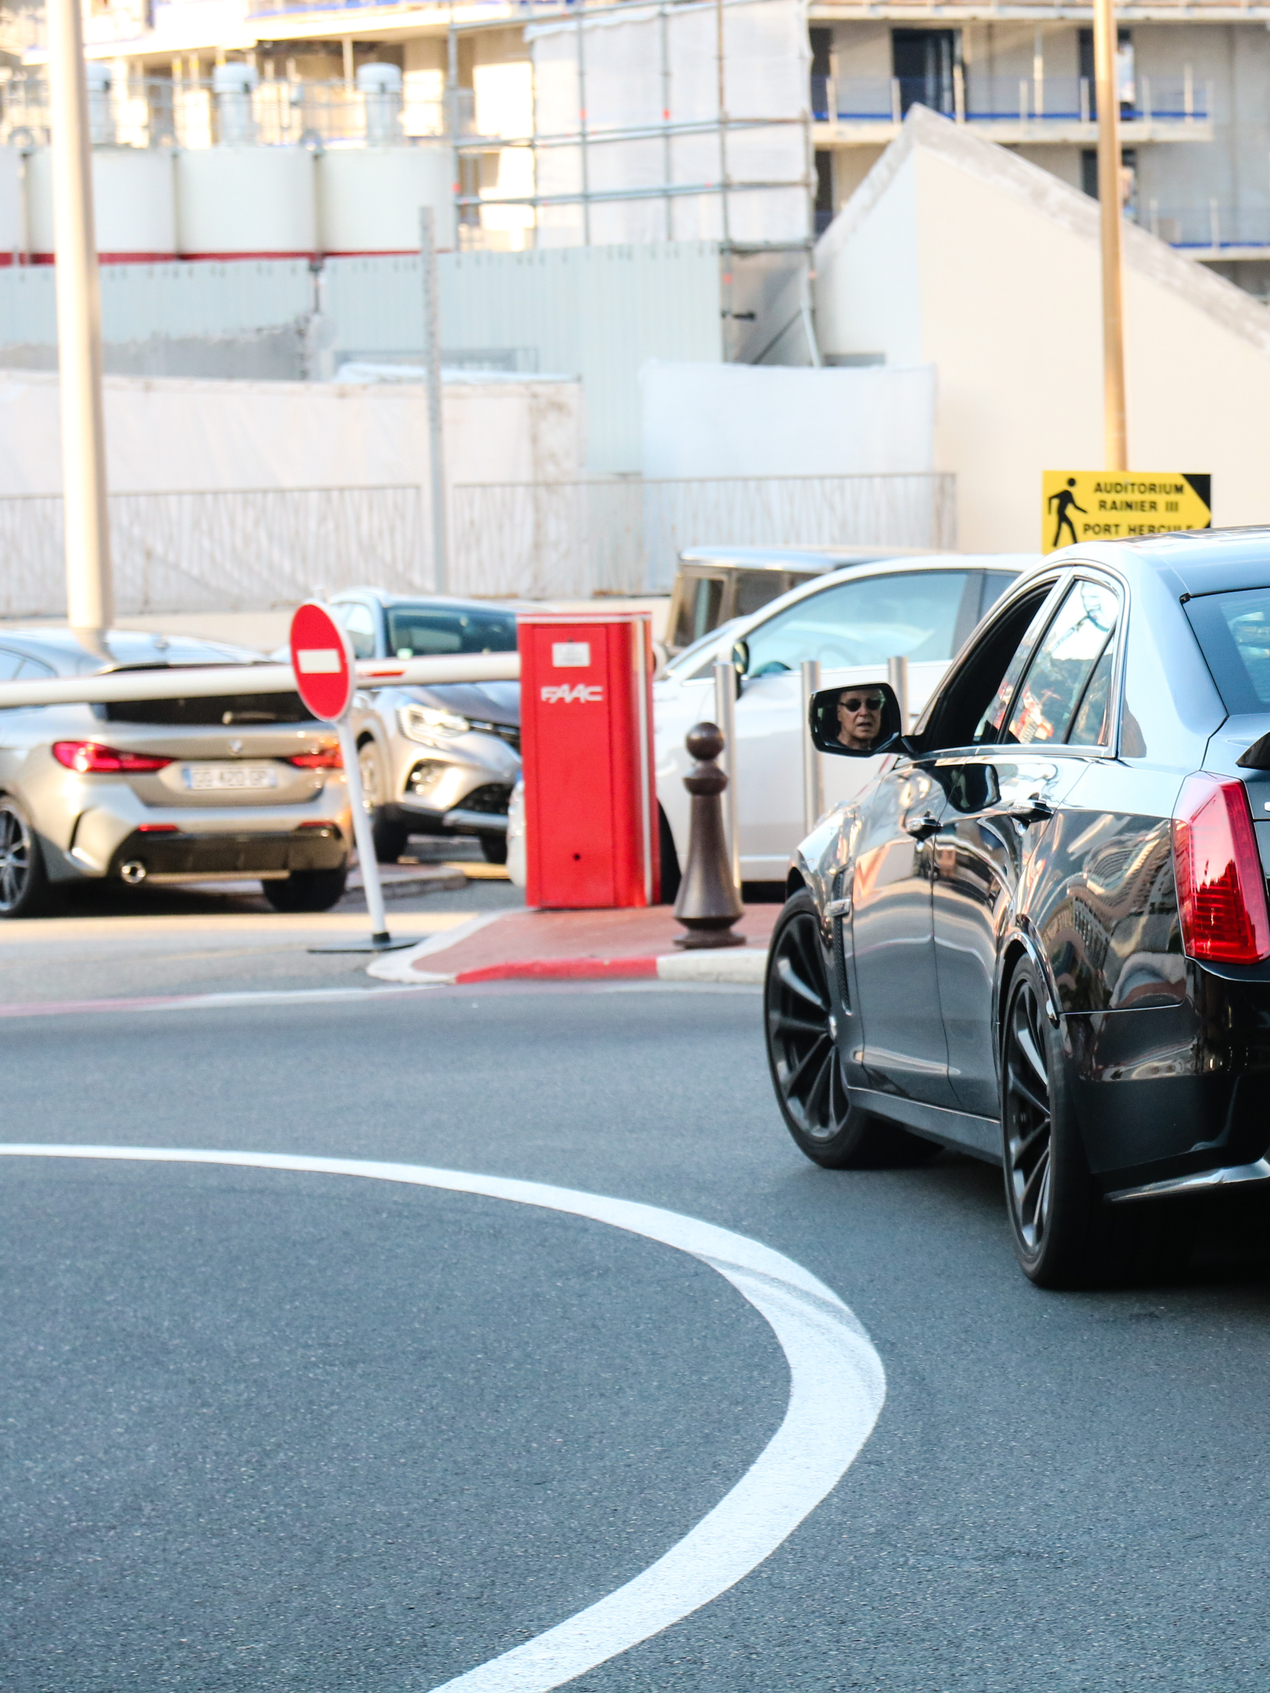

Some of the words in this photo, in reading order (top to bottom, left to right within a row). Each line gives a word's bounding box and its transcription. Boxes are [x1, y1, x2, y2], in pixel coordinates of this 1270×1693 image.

[1094, 482, 1185, 495] AUDITORIUM
[1098, 500, 1158, 513] RAINIER
[1165, 500, 1179, 513] III
[1083, 523, 1121, 536] PORT
[540, 683, 604, 704] FAAC
